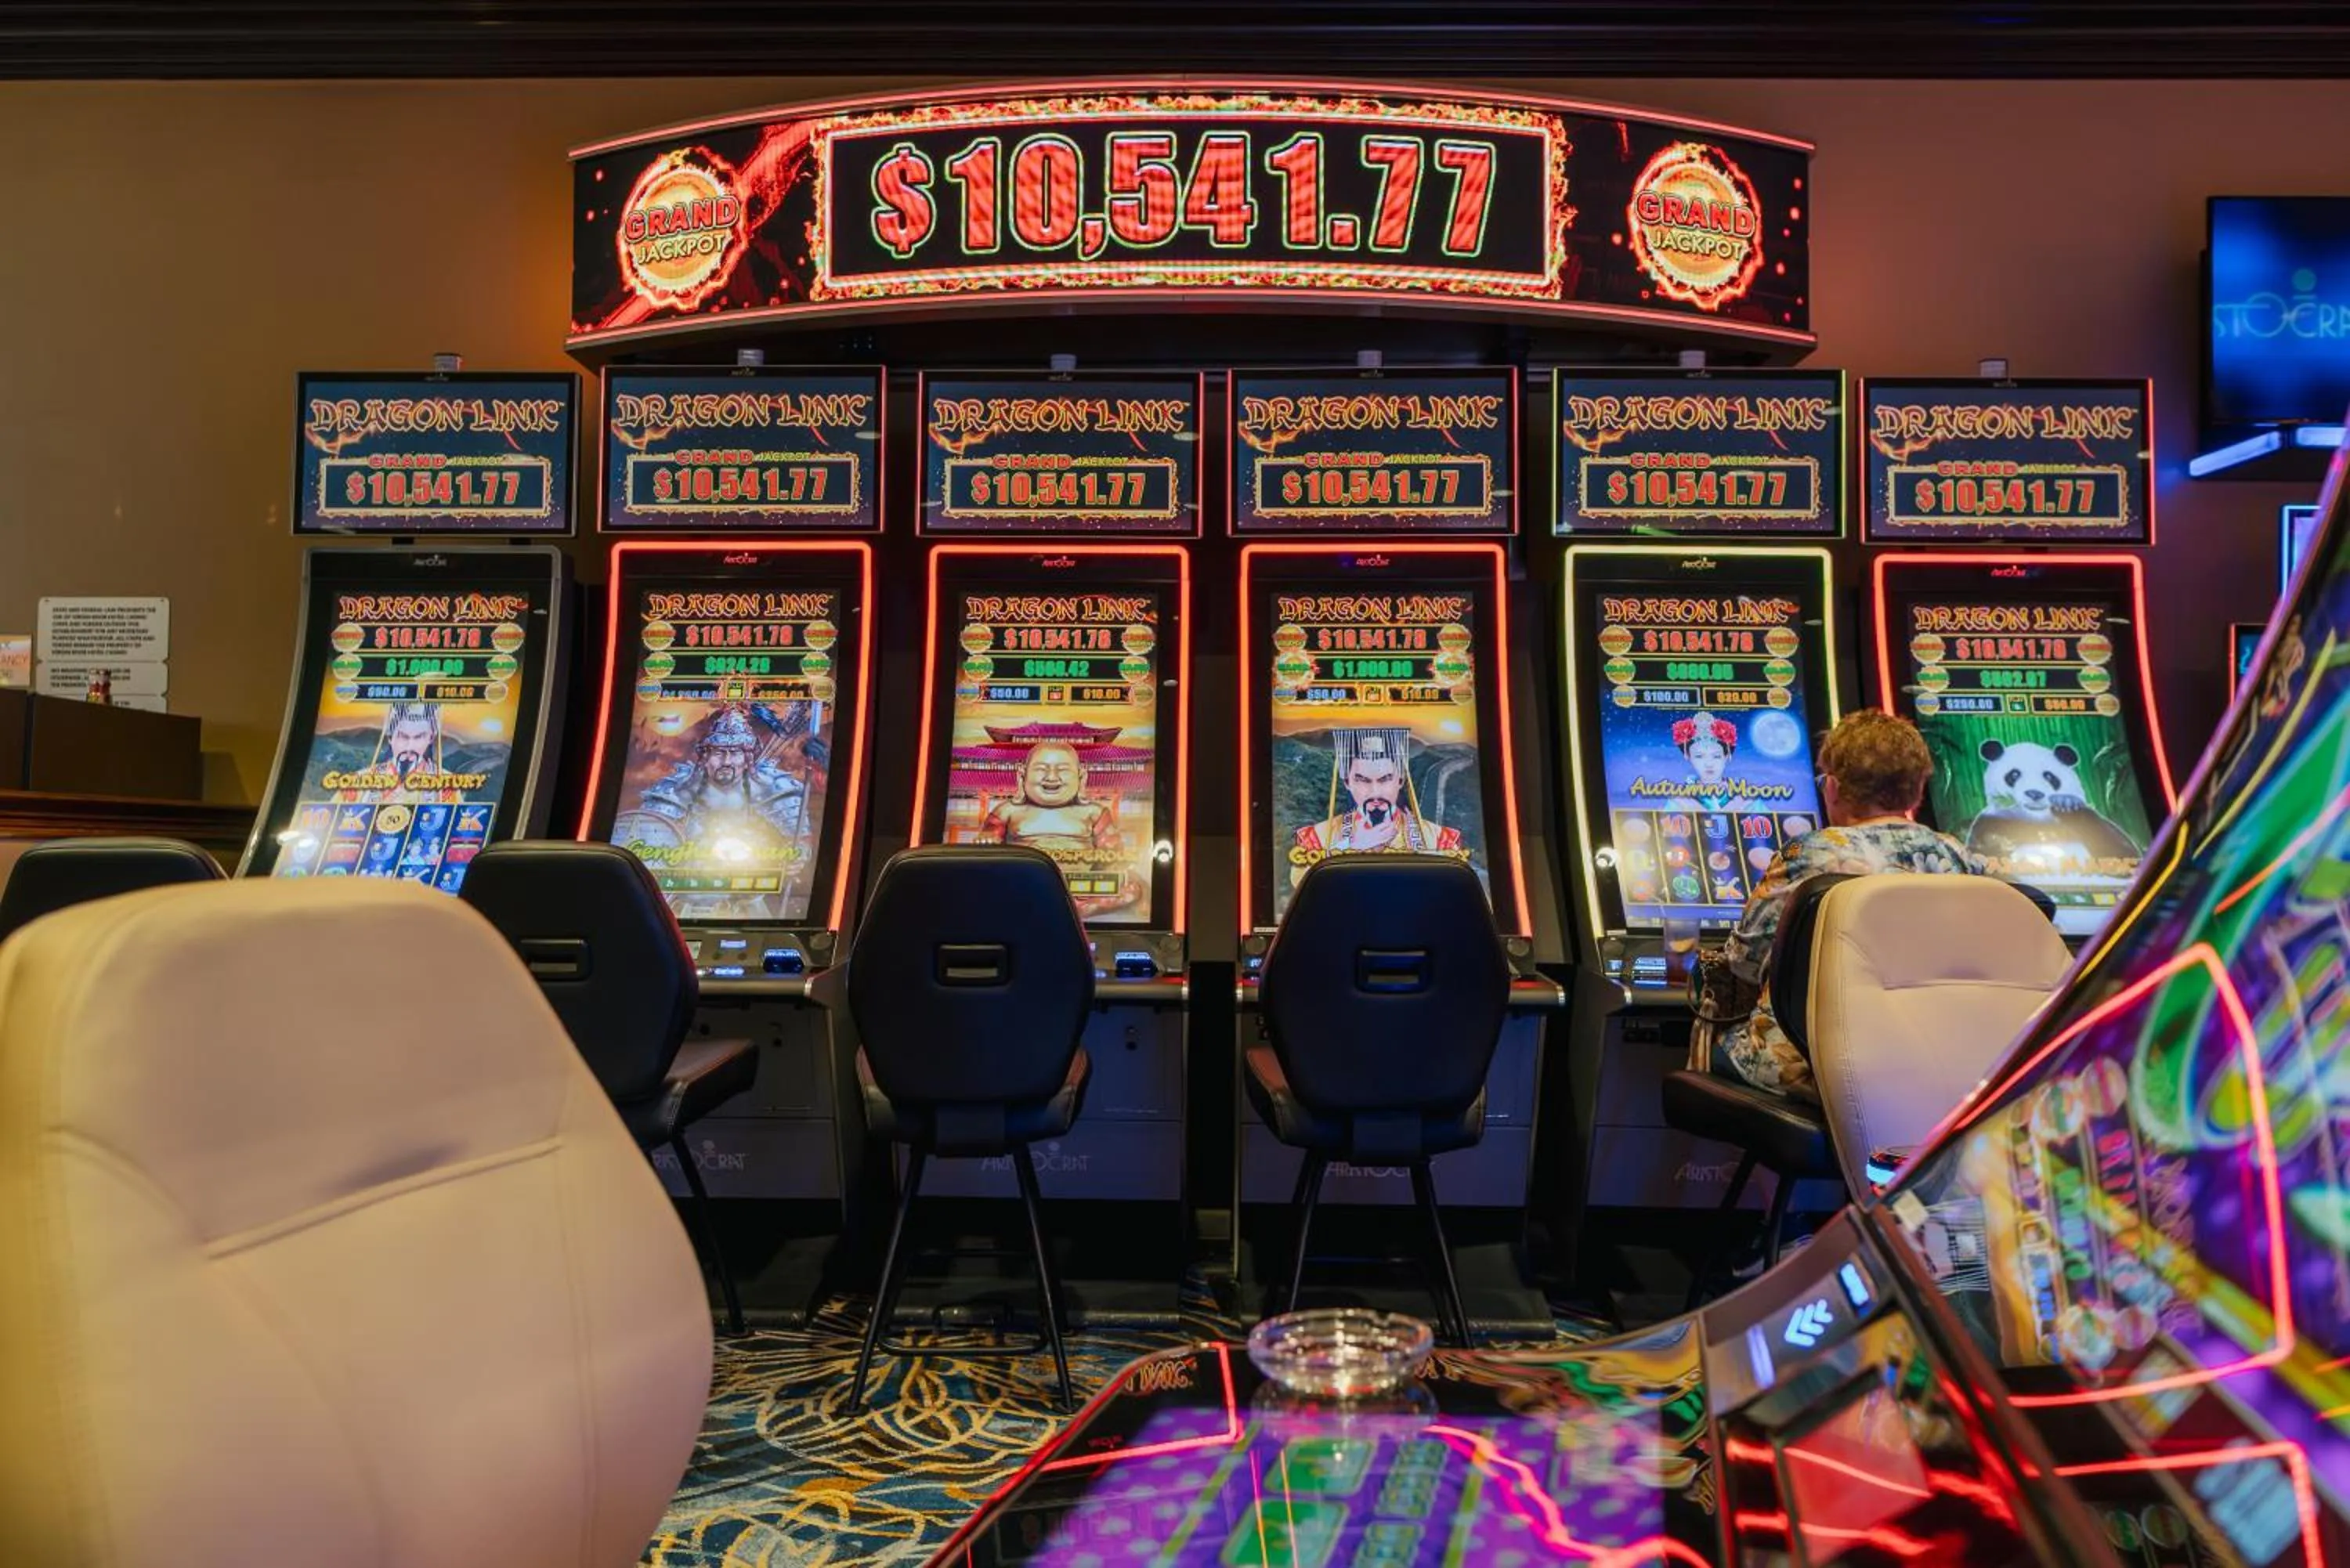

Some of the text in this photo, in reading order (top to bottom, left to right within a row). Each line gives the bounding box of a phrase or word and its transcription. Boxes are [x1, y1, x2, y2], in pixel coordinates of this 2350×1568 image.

[871, 130, 1496, 261] $10,541.77
[624, 194, 739, 245] GRAND
[1635, 190, 1757, 238] GRAND
[637, 230, 727, 266] JACKPOT
[1650, 229, 1748, 261] JACKPOT
[310, 398, 561, 432] DRAGON LINK
[616, 393, 866, 427] DRAGON LINK
[934, 399, 1184, 432] DRAGON LINK
[1242, 396, 1499, 430] DRAGON LINK
[1568, 396, 1826, 431] DRAGON LINK
[1875, 404, 2133, 439] DRAGON LINK
[369, 453, 446, 469] GRAND
[675, 450, 754, 465] GRAND
[992, 454, 1072, 470] GRAND
[1304, 452, 1385, 468] GRAND
[1630, 453, 1712, 468] GRAND
[1936, 461, 2019, 477] GRAND
[346, 471, 521, 507] $10,541.77
[653, 467, 828, 504] $10,541.77
[971, 471, 1146, 508] $10,541.77
[1282, 470, 1459, 507] $10,541.77
[1607, 471, 1787, 508] $10,541.77
[1915, 479, 2095, 515] $10,541.77
[339, 595, 519, 622] DRAGON LINK
[649, 593, 830, 617] DRAGON LINK
[966, 596, 1148, 621] DRAGON LINK
[1278, 596, 1463, 621] DRAGON LINK
[1603, 598, 1789, 624] DRAGON LINK
[1913, 606, 2102, 631] DRAGON LINK
[322, 771, 487, 792] GOLDEN CENTURY
[1630, 776, 1793, 800] Autumn Moon
[1741, 815, 1772, 840] 10
